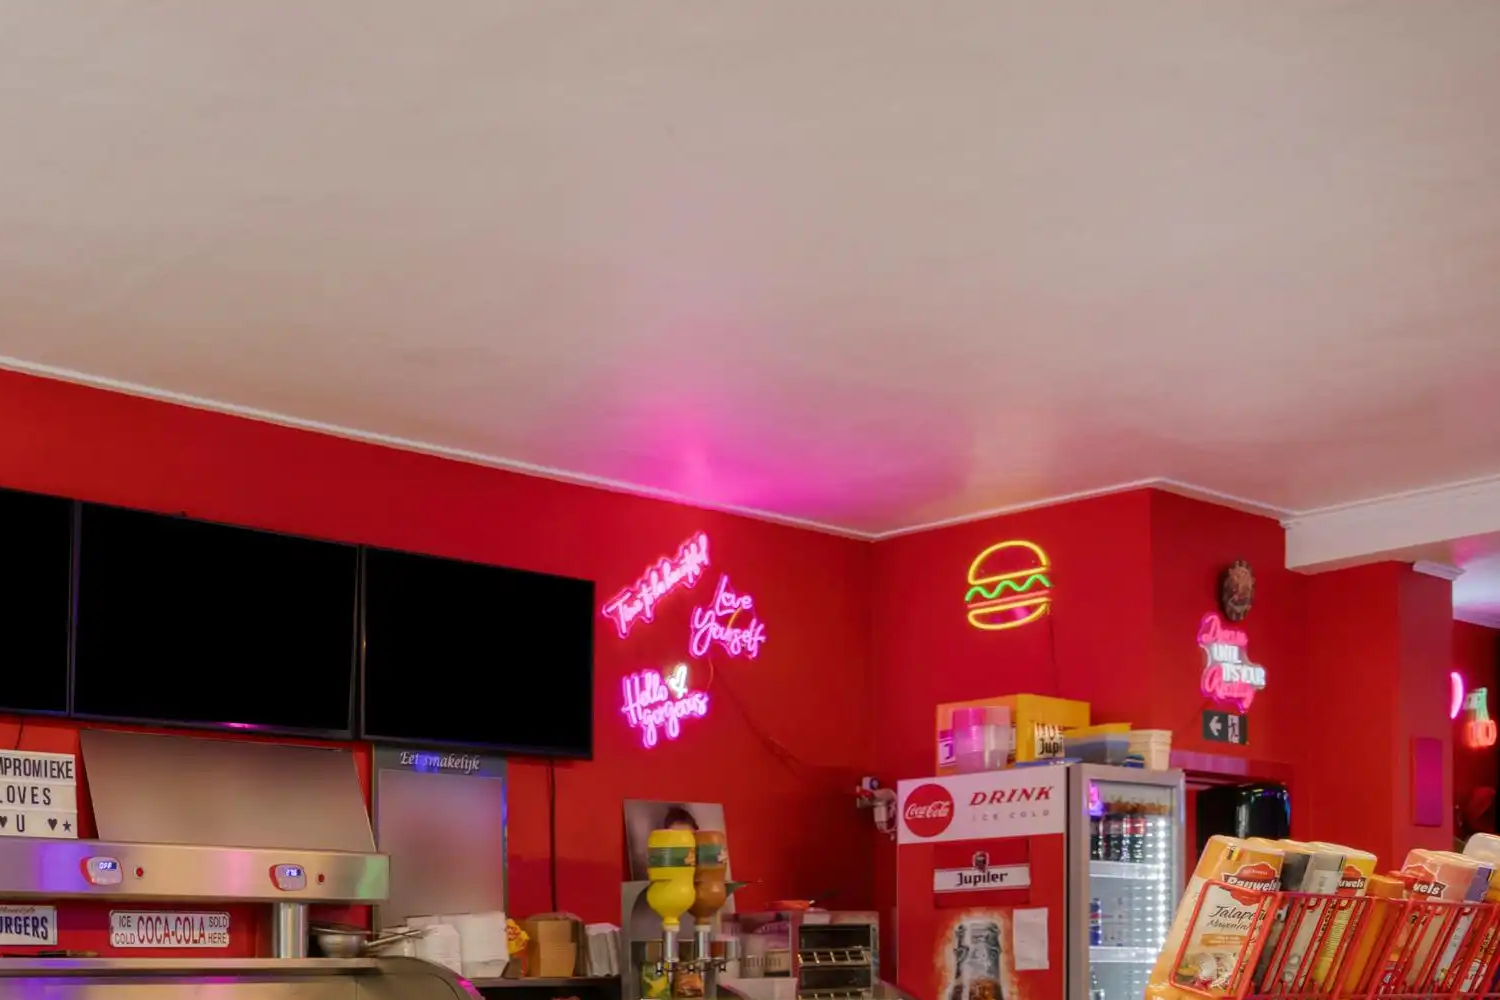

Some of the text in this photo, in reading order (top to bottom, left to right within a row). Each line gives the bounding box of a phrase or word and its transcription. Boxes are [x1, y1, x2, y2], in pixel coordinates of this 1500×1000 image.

[622, 671, 668, 727] Hello
[399, 751, 481, 774] Eet smakelijk
[969, 786, 1054, 806] DRINK
[15, 814, 26, 832] U
[972, 809, 1051, 822] ICE COLD
[98, 861, 112, 870] OFF
[956, 872, 1008, 885] Jupiler
[114, 915, 135, 945] ICE COLD
[137, 916, 207, 945] COCA-COLA
[207, 916, 228, 945] SOLD HERE
